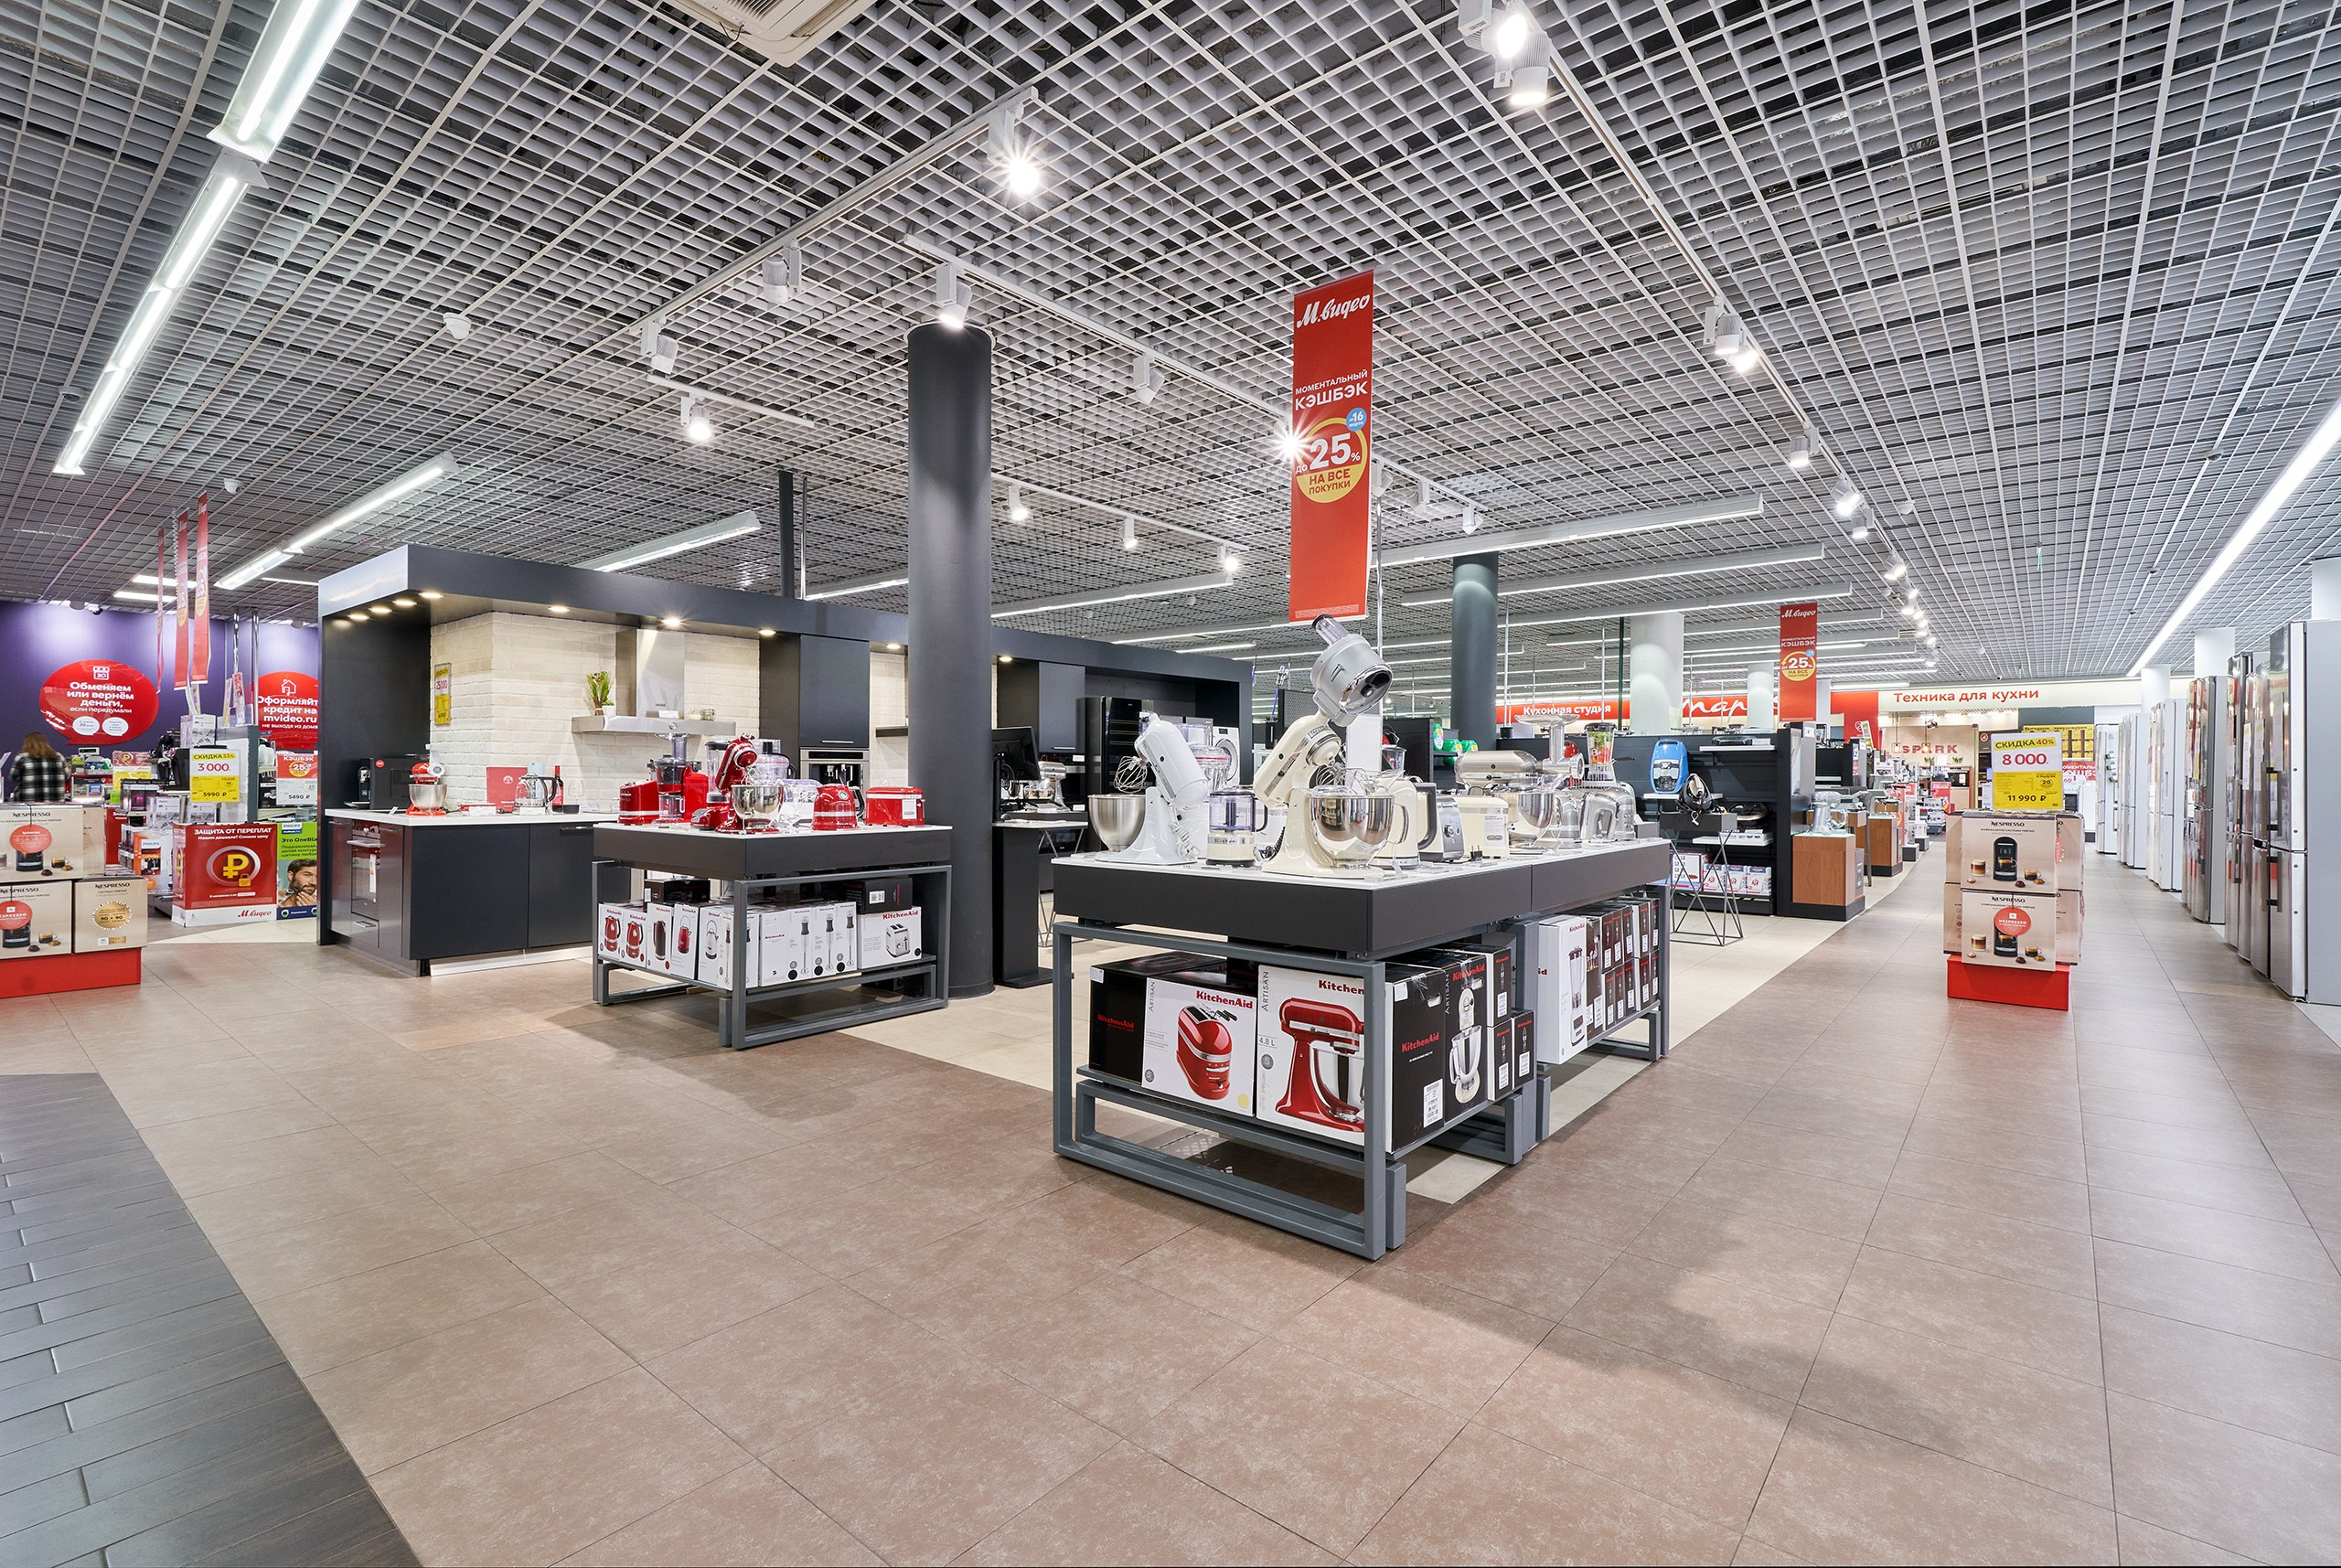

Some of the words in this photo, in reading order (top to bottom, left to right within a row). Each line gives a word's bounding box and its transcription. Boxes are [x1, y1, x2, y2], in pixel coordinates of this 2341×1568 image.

[1297, 294, 1370, 328] М.видео
[1295, 368, 1368, 395] МОМЕНТАЛЬНЫЙ
[1295, 381, 1368, 411] КЭШБЭК
[1295, 464, 1308, 474] до
[1309, 474, 1325, 485] НА
[1328, 468, 1351, 482] ВСЕ
[1309, 480, 1351, 495] ПОКУПКИ
[1781, 609, 1816, 618] М.видео
[69, 682, 131, 692] Обменяем
[92, 691, 134, 701] вернём
[1894, 692, 1955, 702] Техника
[1959, 692, 1987, 702] для
[1992, 690, 2039, 702] кухни
[263, 706, 302, 715] кредит
[1523, 706, 1572, 716] Кухонная
[1573, 705, 1611, 716] студия
[263, 715, 317, 723] mvideo.ru
[1995, 740, 2036, 749] СКИДКА
[2002, 753, 2012, 765] 8
[198, 763, 205, 772] 3
[882, 911, 918, 920] KitchenAid
[1261, 971, 1269, 1012] ARTISAN
[1196, 990, 1254, 1009] KitchenAid
[1097, 1014, 1135, 1029] KitchenAid
[1258, 1037, 1270, 1045] 4.8
[1401, 1031, 1440, 1052] KitchenAid
